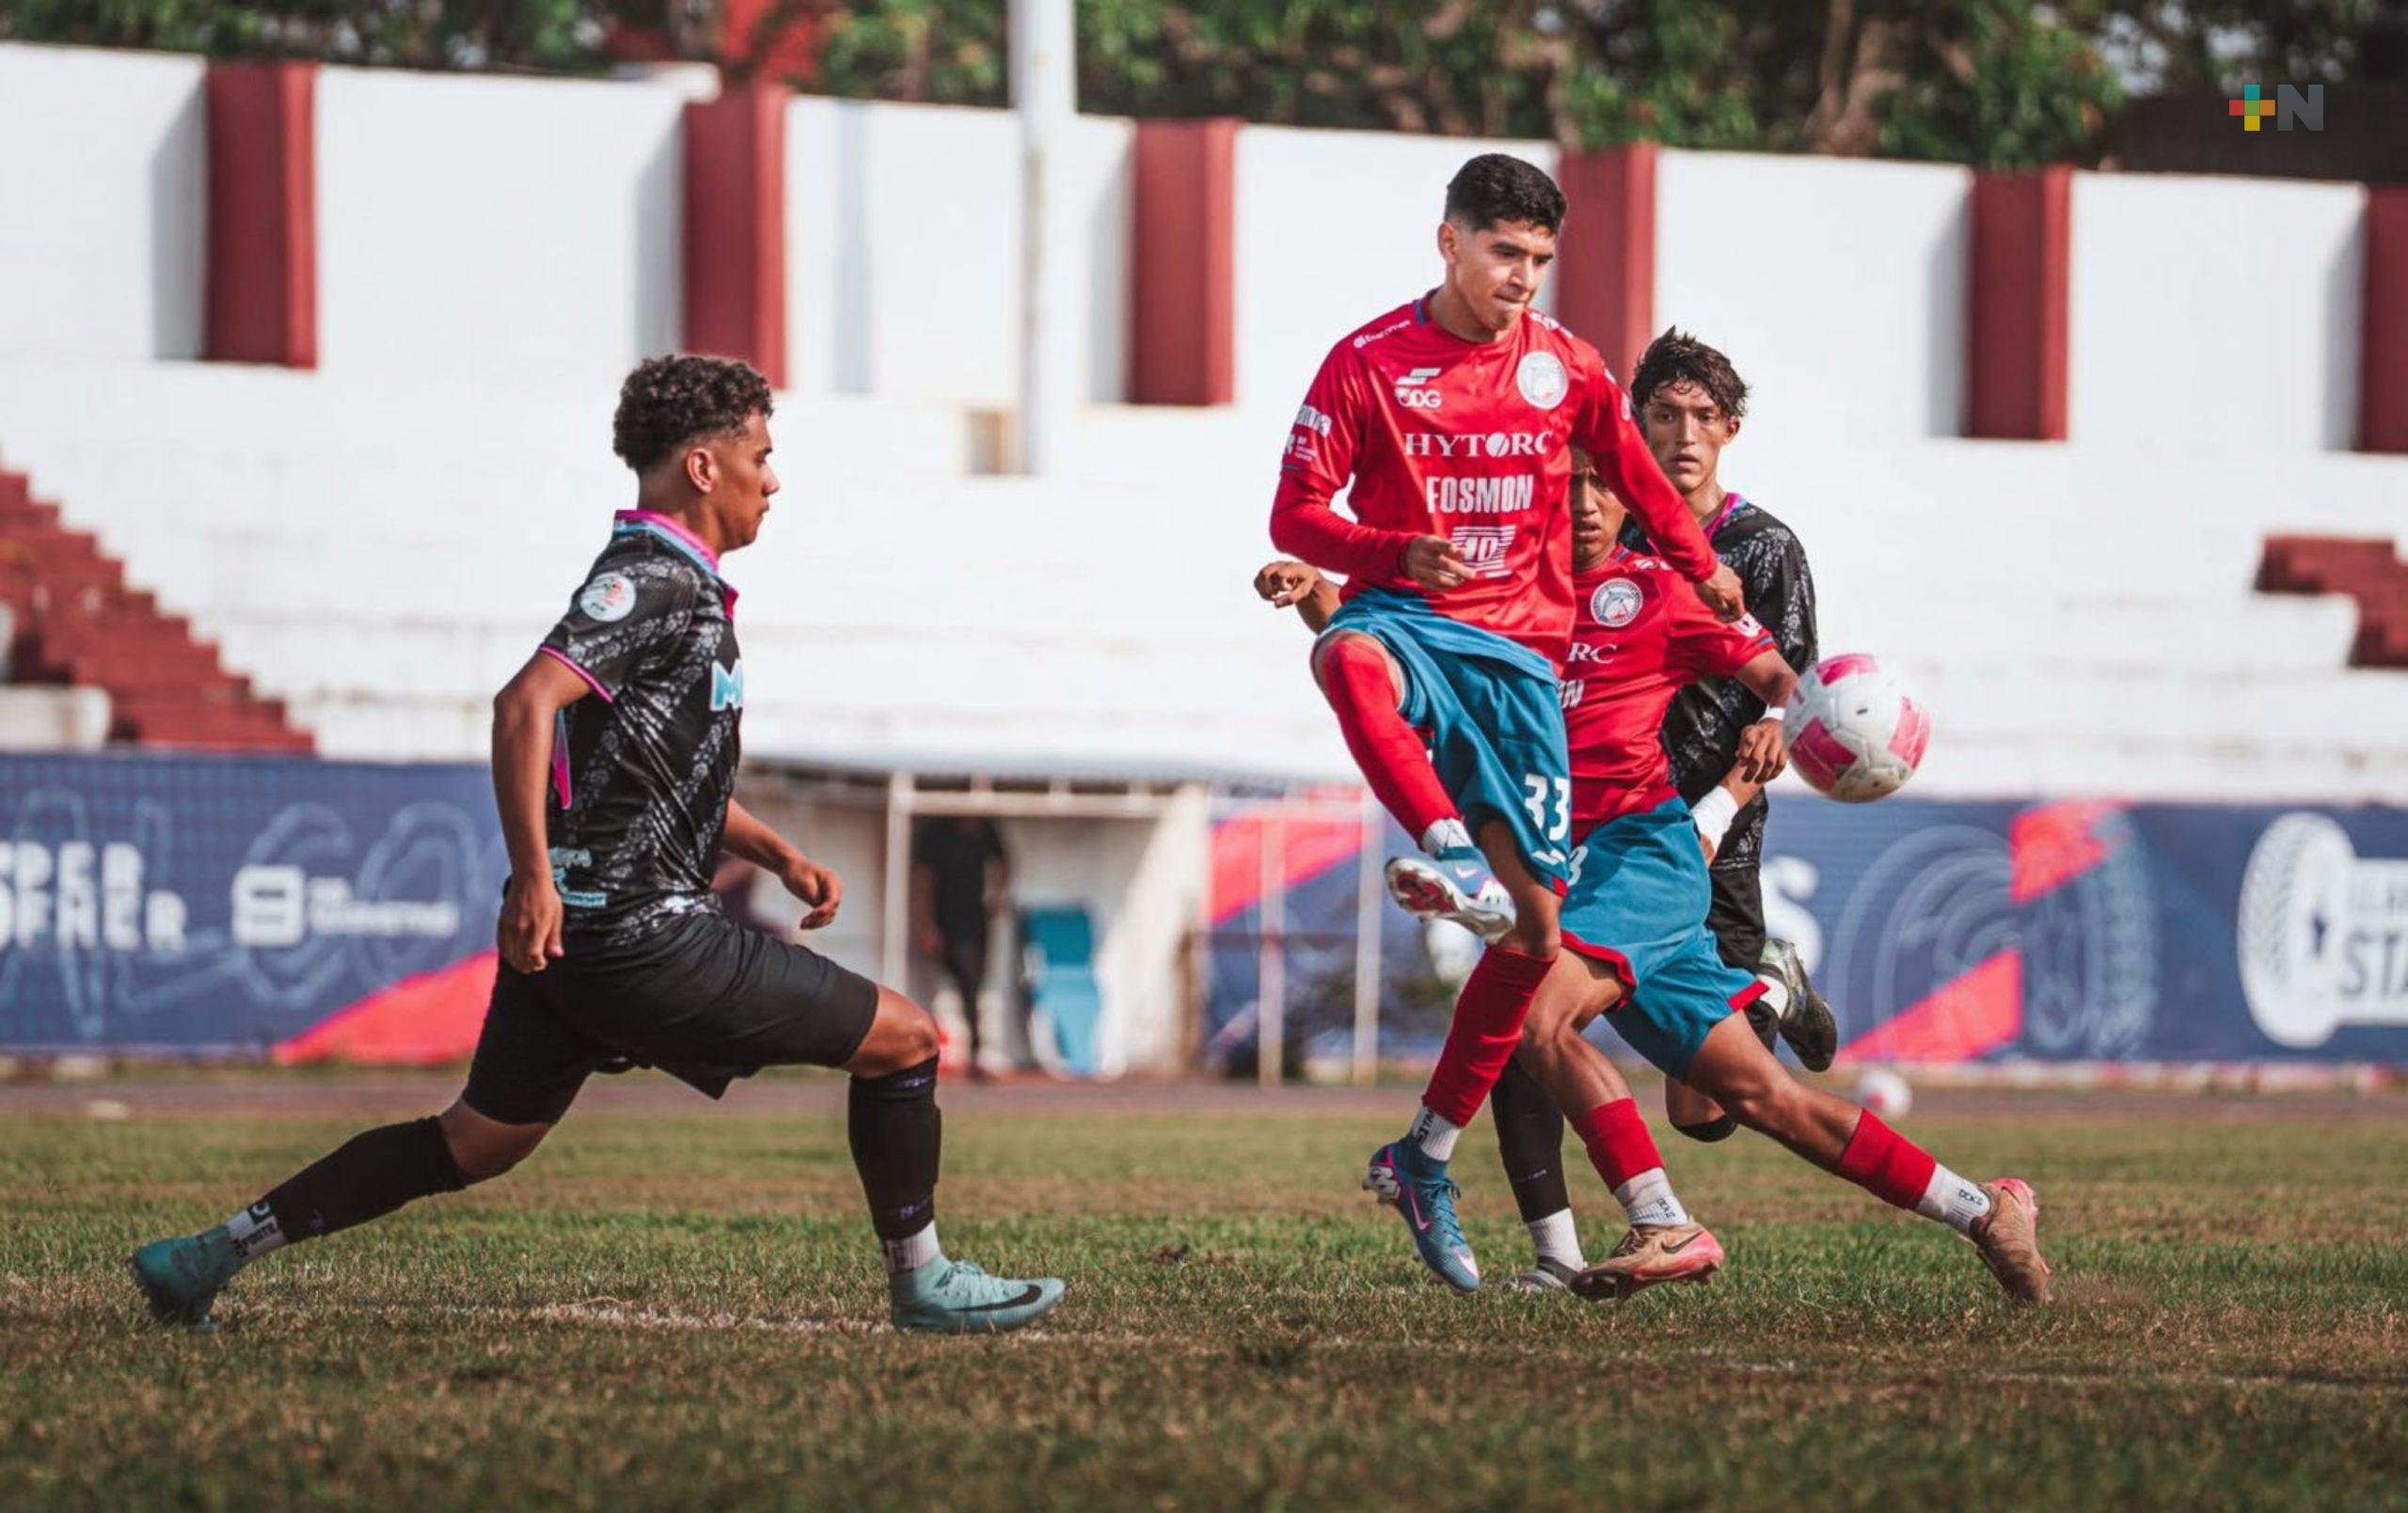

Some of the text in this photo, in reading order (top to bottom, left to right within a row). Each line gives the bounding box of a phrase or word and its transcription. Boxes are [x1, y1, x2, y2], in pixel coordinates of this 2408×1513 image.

[1404, 432, 1553, 458] HYTORC
[1426, 474, 1534, 514] FOSMON
[1525, 773, 1570, 842] 33
[2338, 925, 2408, 999] ST
